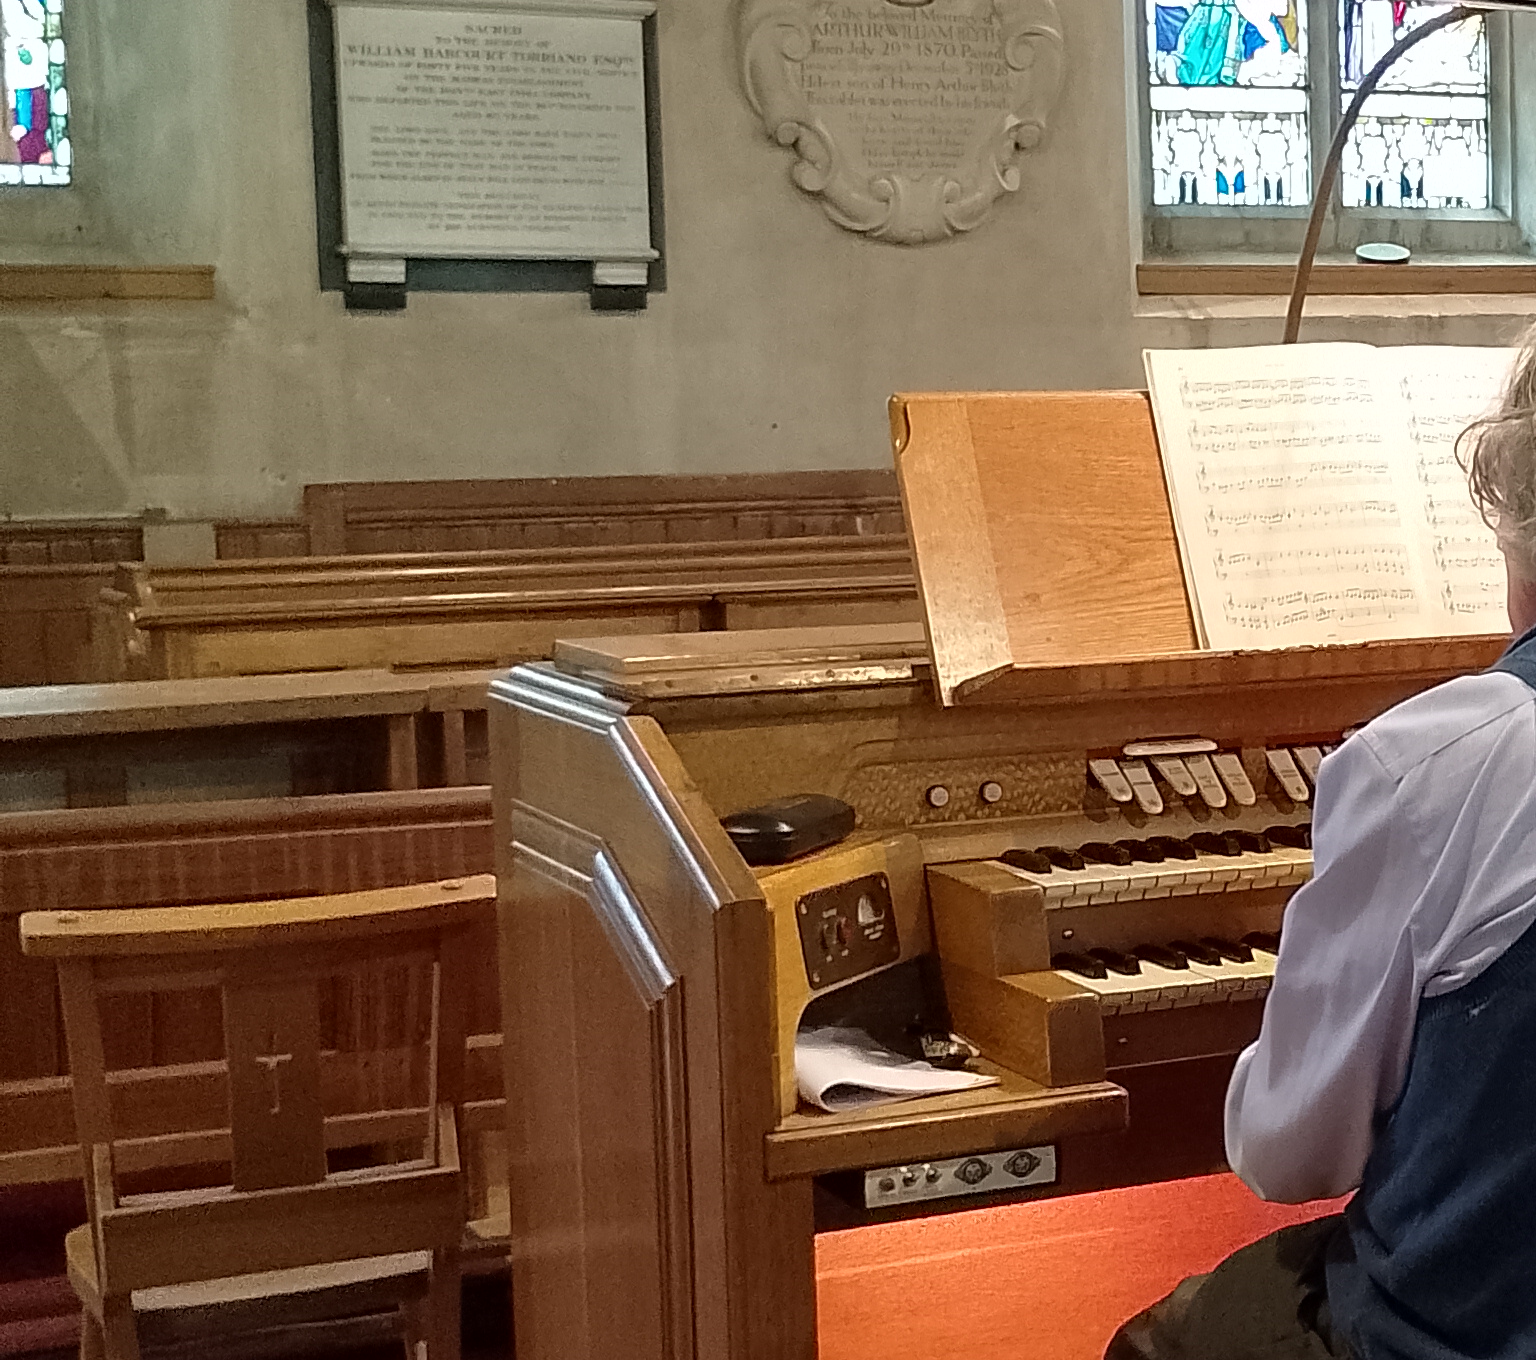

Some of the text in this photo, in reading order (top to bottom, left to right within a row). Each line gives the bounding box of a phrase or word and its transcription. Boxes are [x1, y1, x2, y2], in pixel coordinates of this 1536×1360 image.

[464, 24, 522, 35] SACRED
[812, 23, 883, 38] ARTHUR
[454, 36, 478, 46] THE
[347, 44, 416, 57] WILLIAM
[423, 48, 507, 62] HARCOURT
